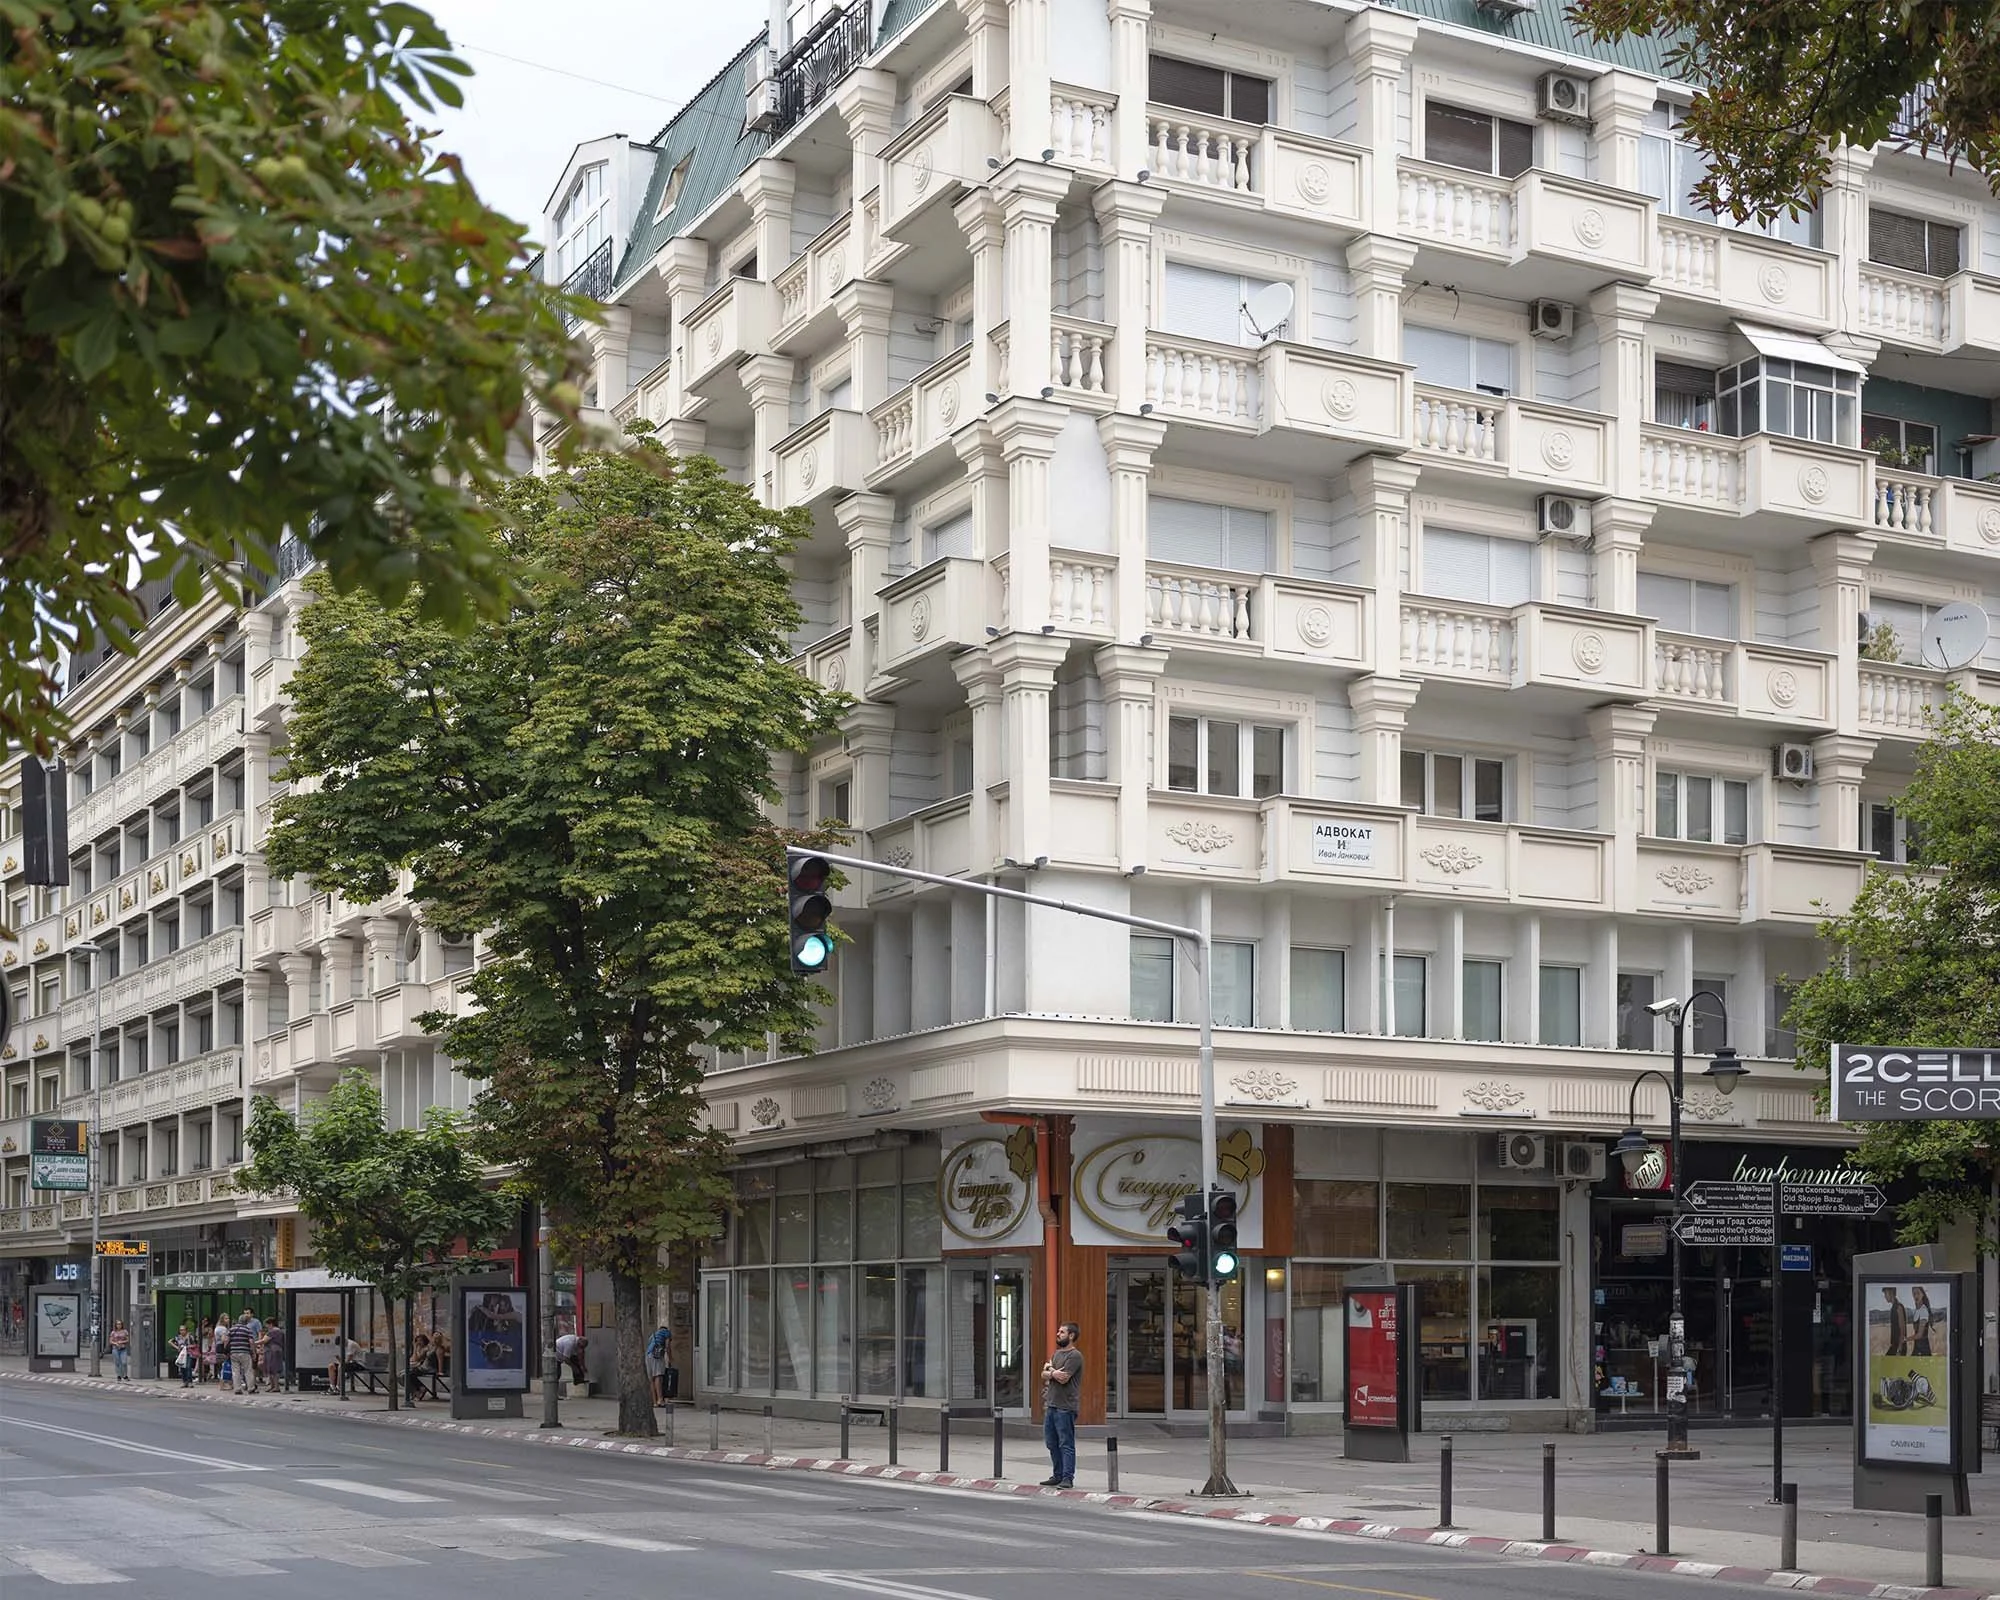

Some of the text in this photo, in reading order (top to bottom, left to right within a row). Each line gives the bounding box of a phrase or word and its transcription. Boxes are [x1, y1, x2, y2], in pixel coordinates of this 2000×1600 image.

[1316, 825, 1372, 840] АДВОКАТ
[1318, 849, 1337, 858] Иван
[1845, 1053, 2000, 1083] 2CELL
[1855, 1088, 2000, 1112] THE SCOR
[1783, 1186, 1804, 1194] Стара
[1797, 1195, 1822, 1205] Skopje
[1838, 1204, 1864, 1213] Shkupit
[1694, 1217, 1714, 1227] Музеј
[1727, 1217, 1745, 1226] Град
[1747, 1218, 1772, 1227] Скопје
[1736, 1227, 1748, 1235] City
[1890, 1439, 1926, 1448] CALVIN KLEIN
